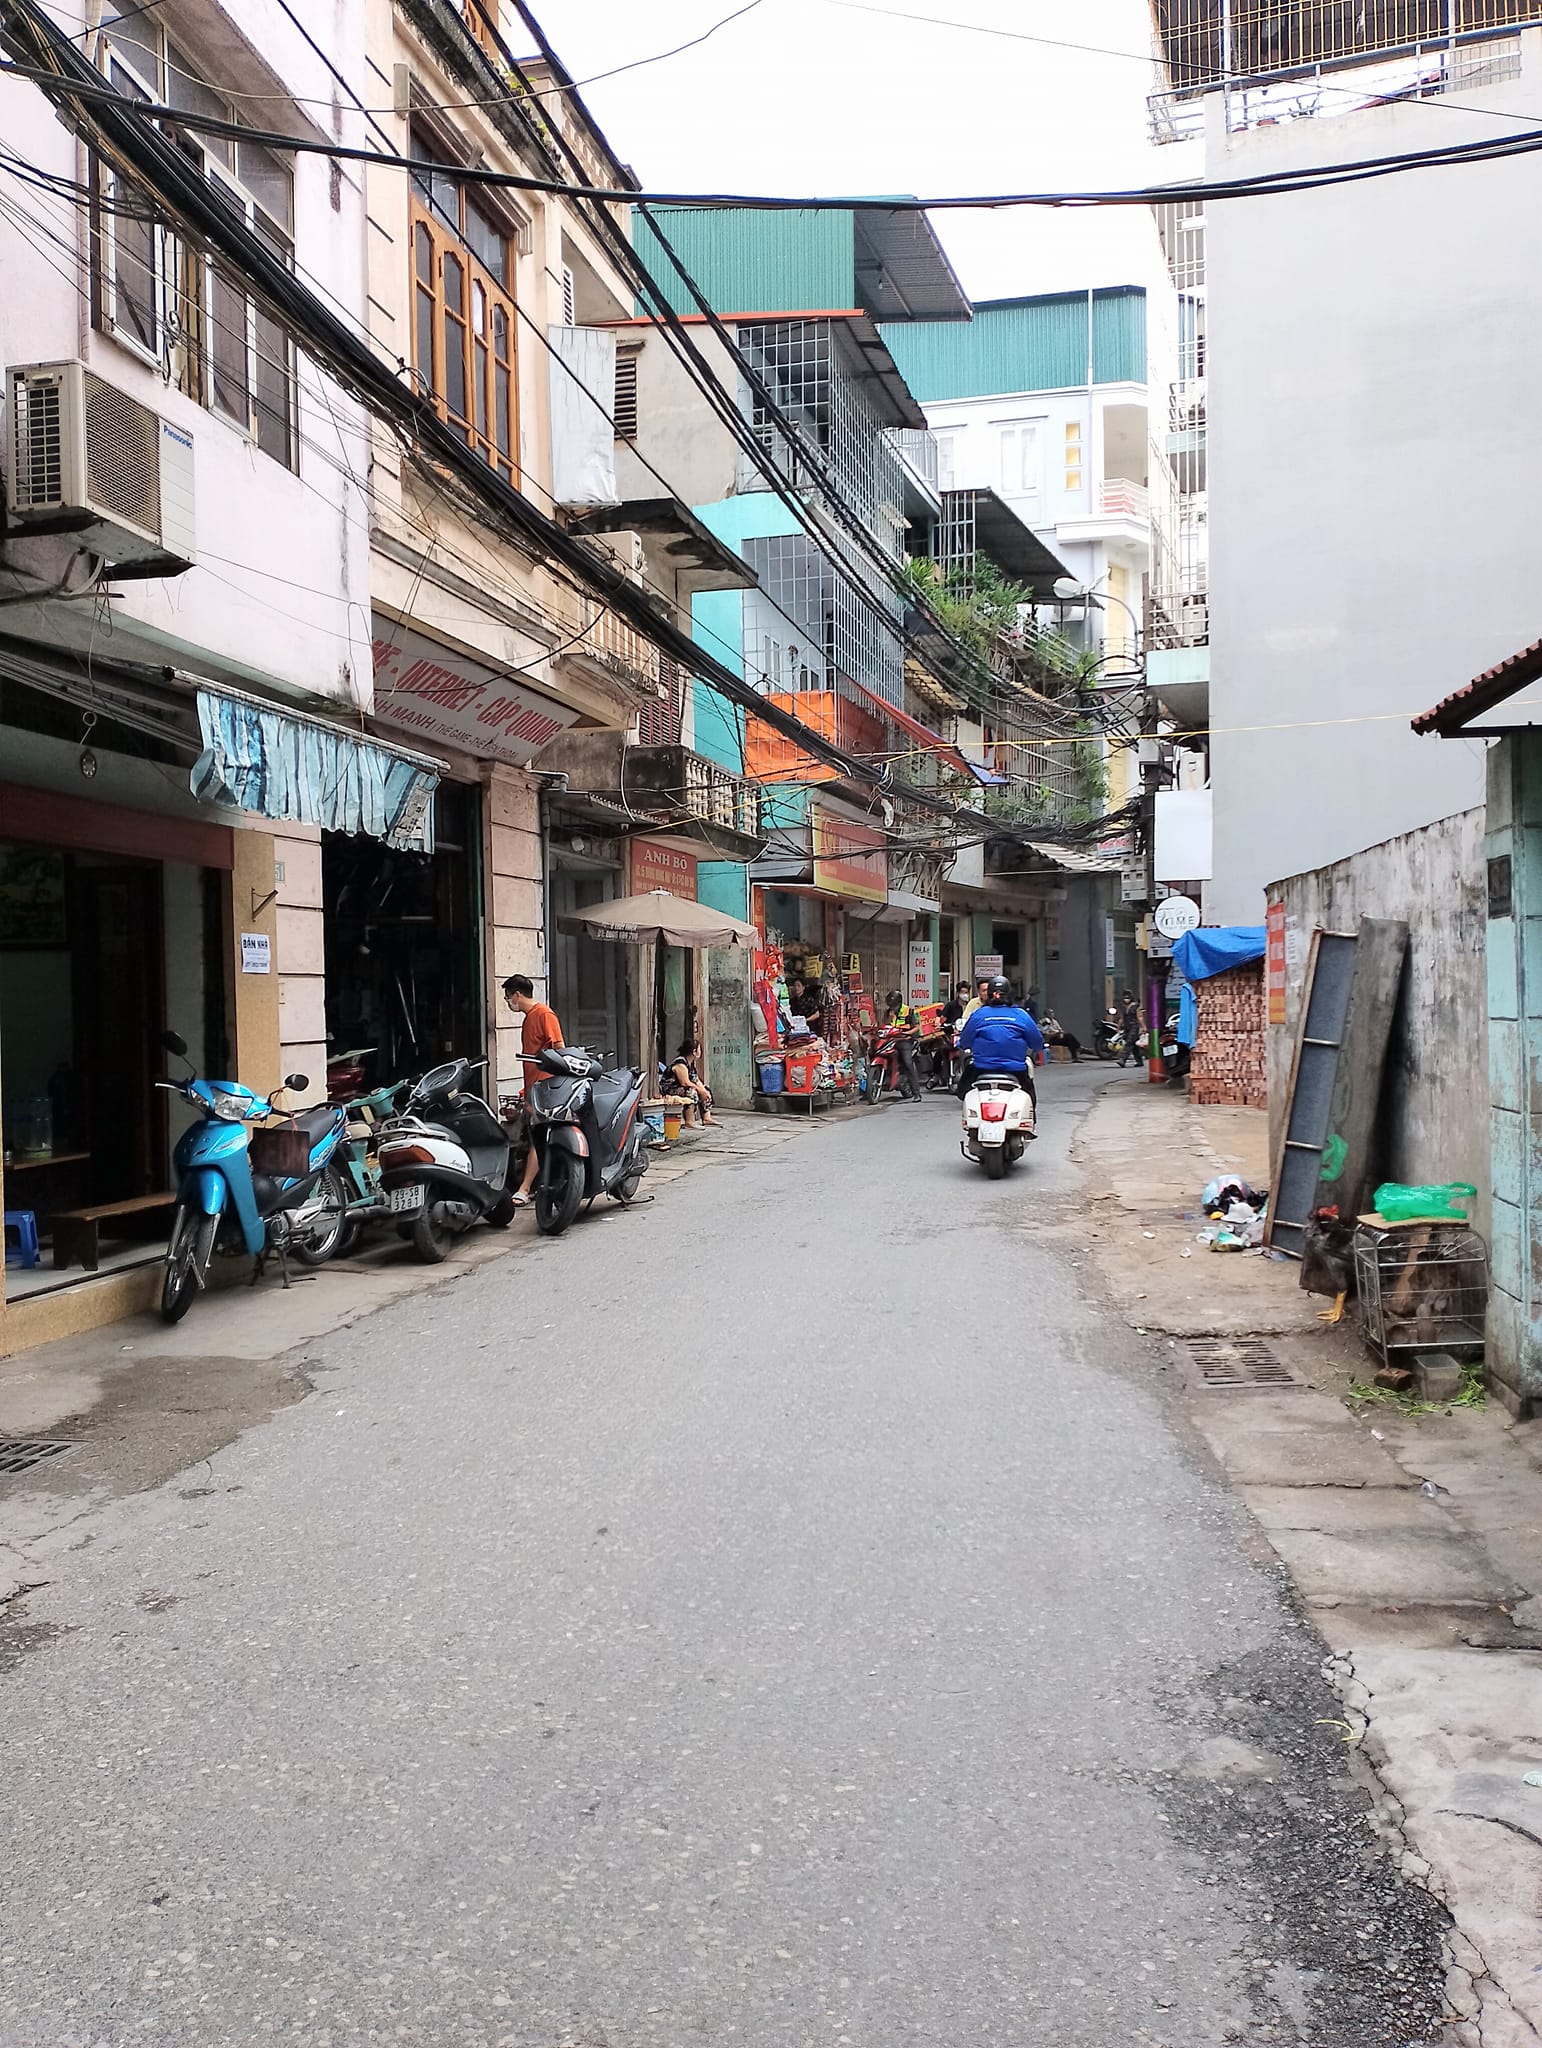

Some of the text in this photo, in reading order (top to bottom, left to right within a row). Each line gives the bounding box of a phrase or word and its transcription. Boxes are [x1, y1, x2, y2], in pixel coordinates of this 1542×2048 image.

[394, 660, 487, 712] INTERNET
[477, 696, 522, 727] CÁP
[505, 710, 563, 746] QUANG
[644, 850, 670, 866] ANH
